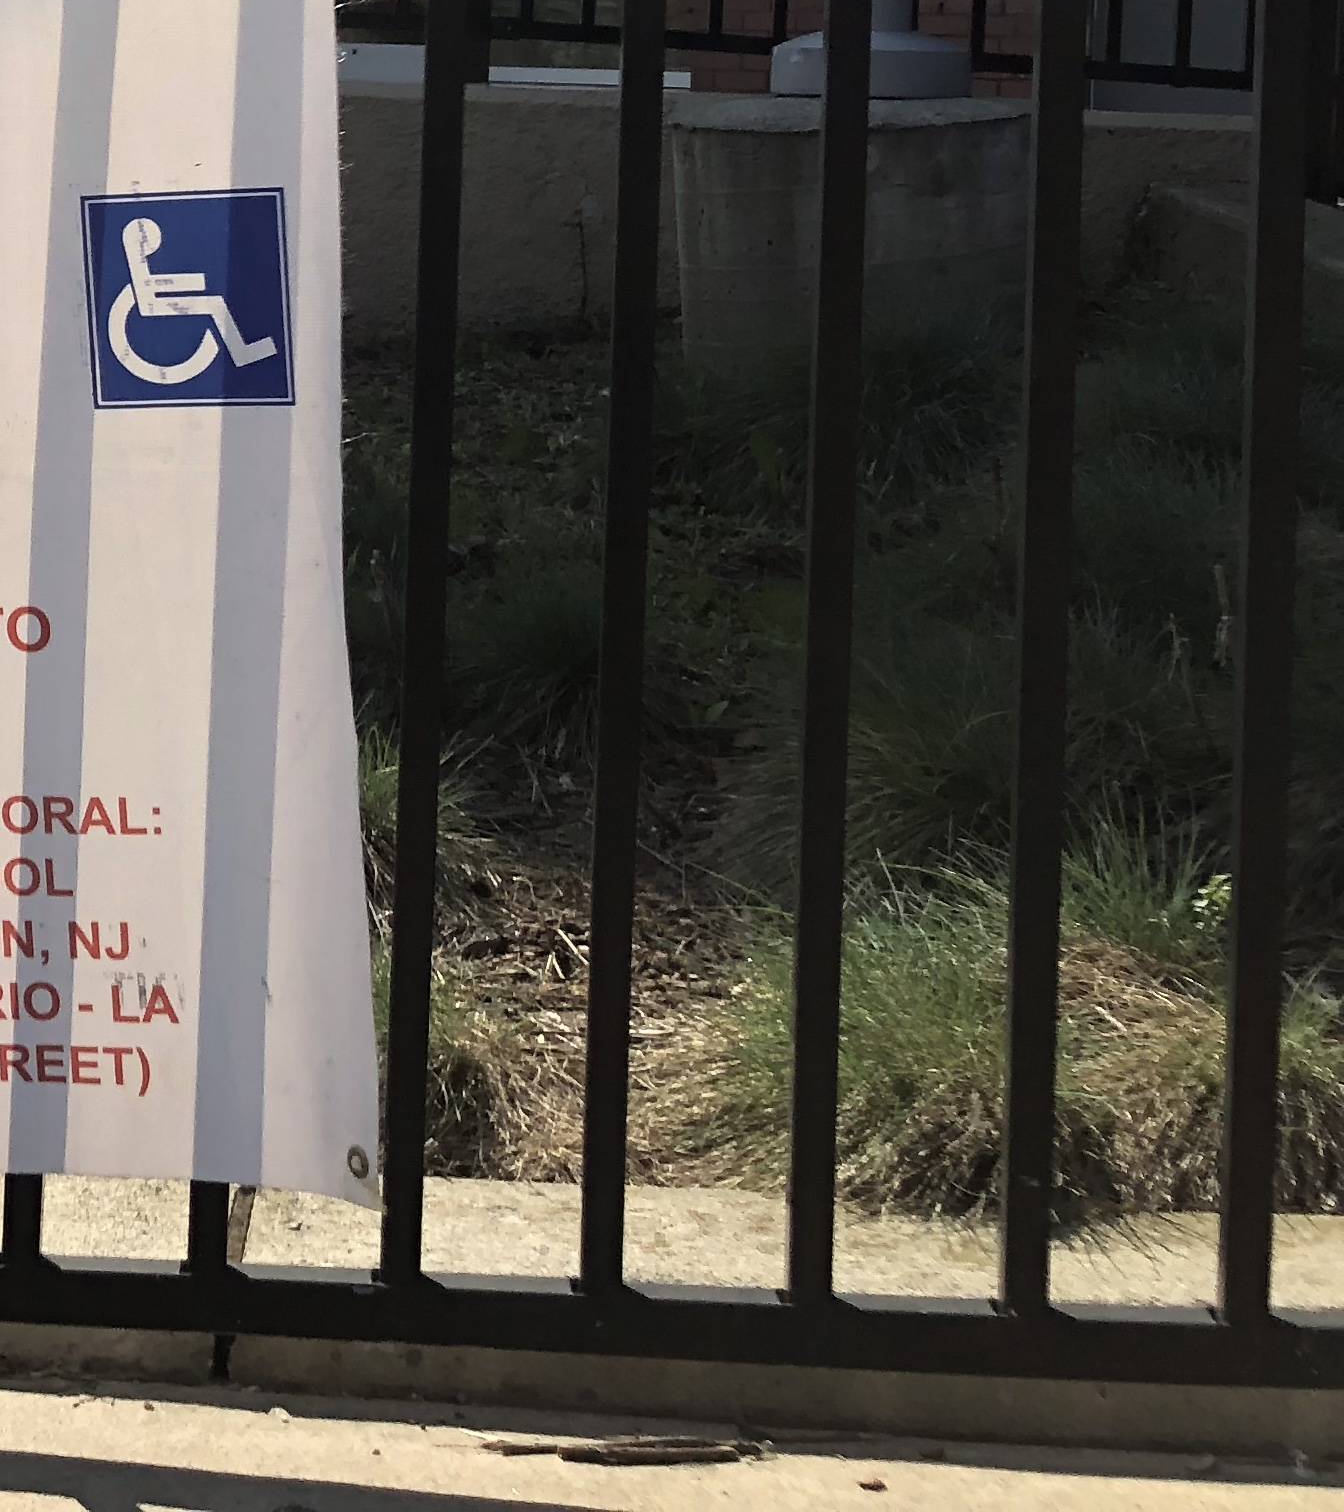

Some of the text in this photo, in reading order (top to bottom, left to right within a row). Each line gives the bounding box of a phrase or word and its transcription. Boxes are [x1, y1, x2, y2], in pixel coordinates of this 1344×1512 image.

[68, 920, 130, 961] NJ
[77, 1001, 94, 1013] -
[110, 984, 180, 1025] LA
